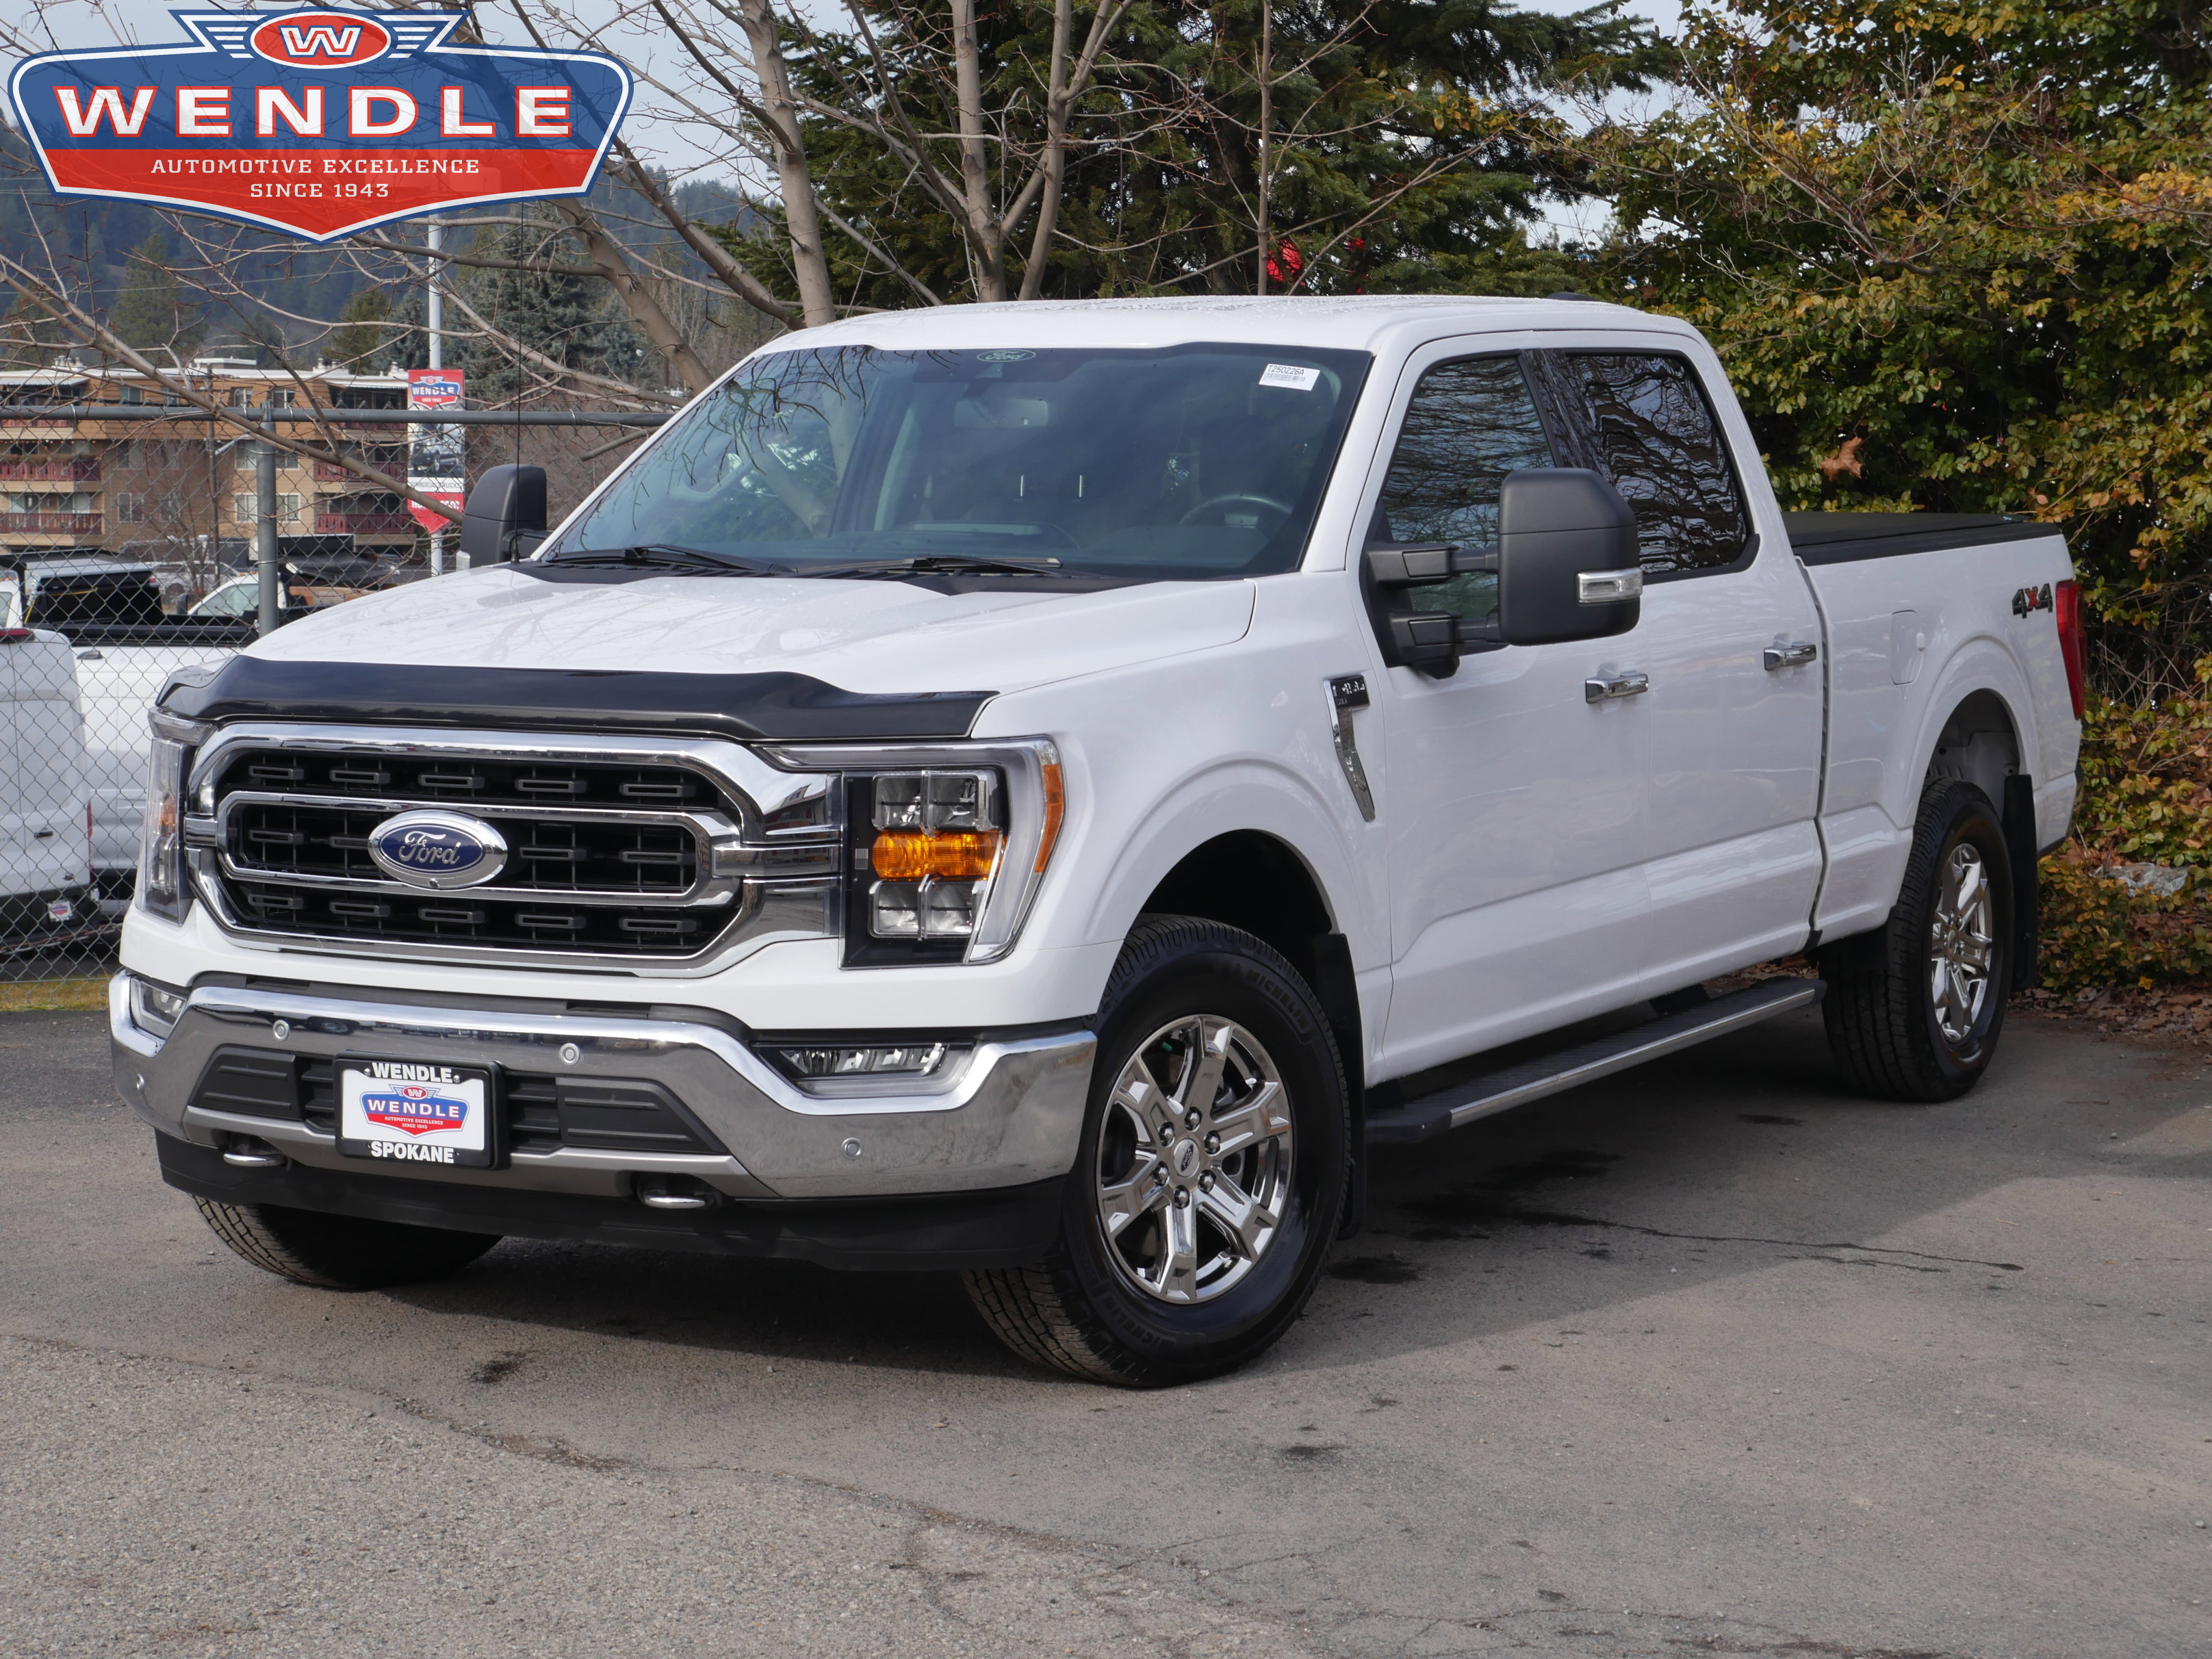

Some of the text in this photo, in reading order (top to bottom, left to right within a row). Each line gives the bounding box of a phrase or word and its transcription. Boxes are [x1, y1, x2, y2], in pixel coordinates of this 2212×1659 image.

[986, 350, 1027, 361] Ford
[1268, 365, 1304, 376] T250226A
[412, 387, 455, 395] WENDLE
[398, 830, 461, 865] Ford
[1244, 968, 1310, 1030] MICHELIN
[372, 1062, 453, 1083] WENDLE
[368, 1099, 459, 1118] WENDLE
[370, 1141, 454, 1163] SPOKANE
